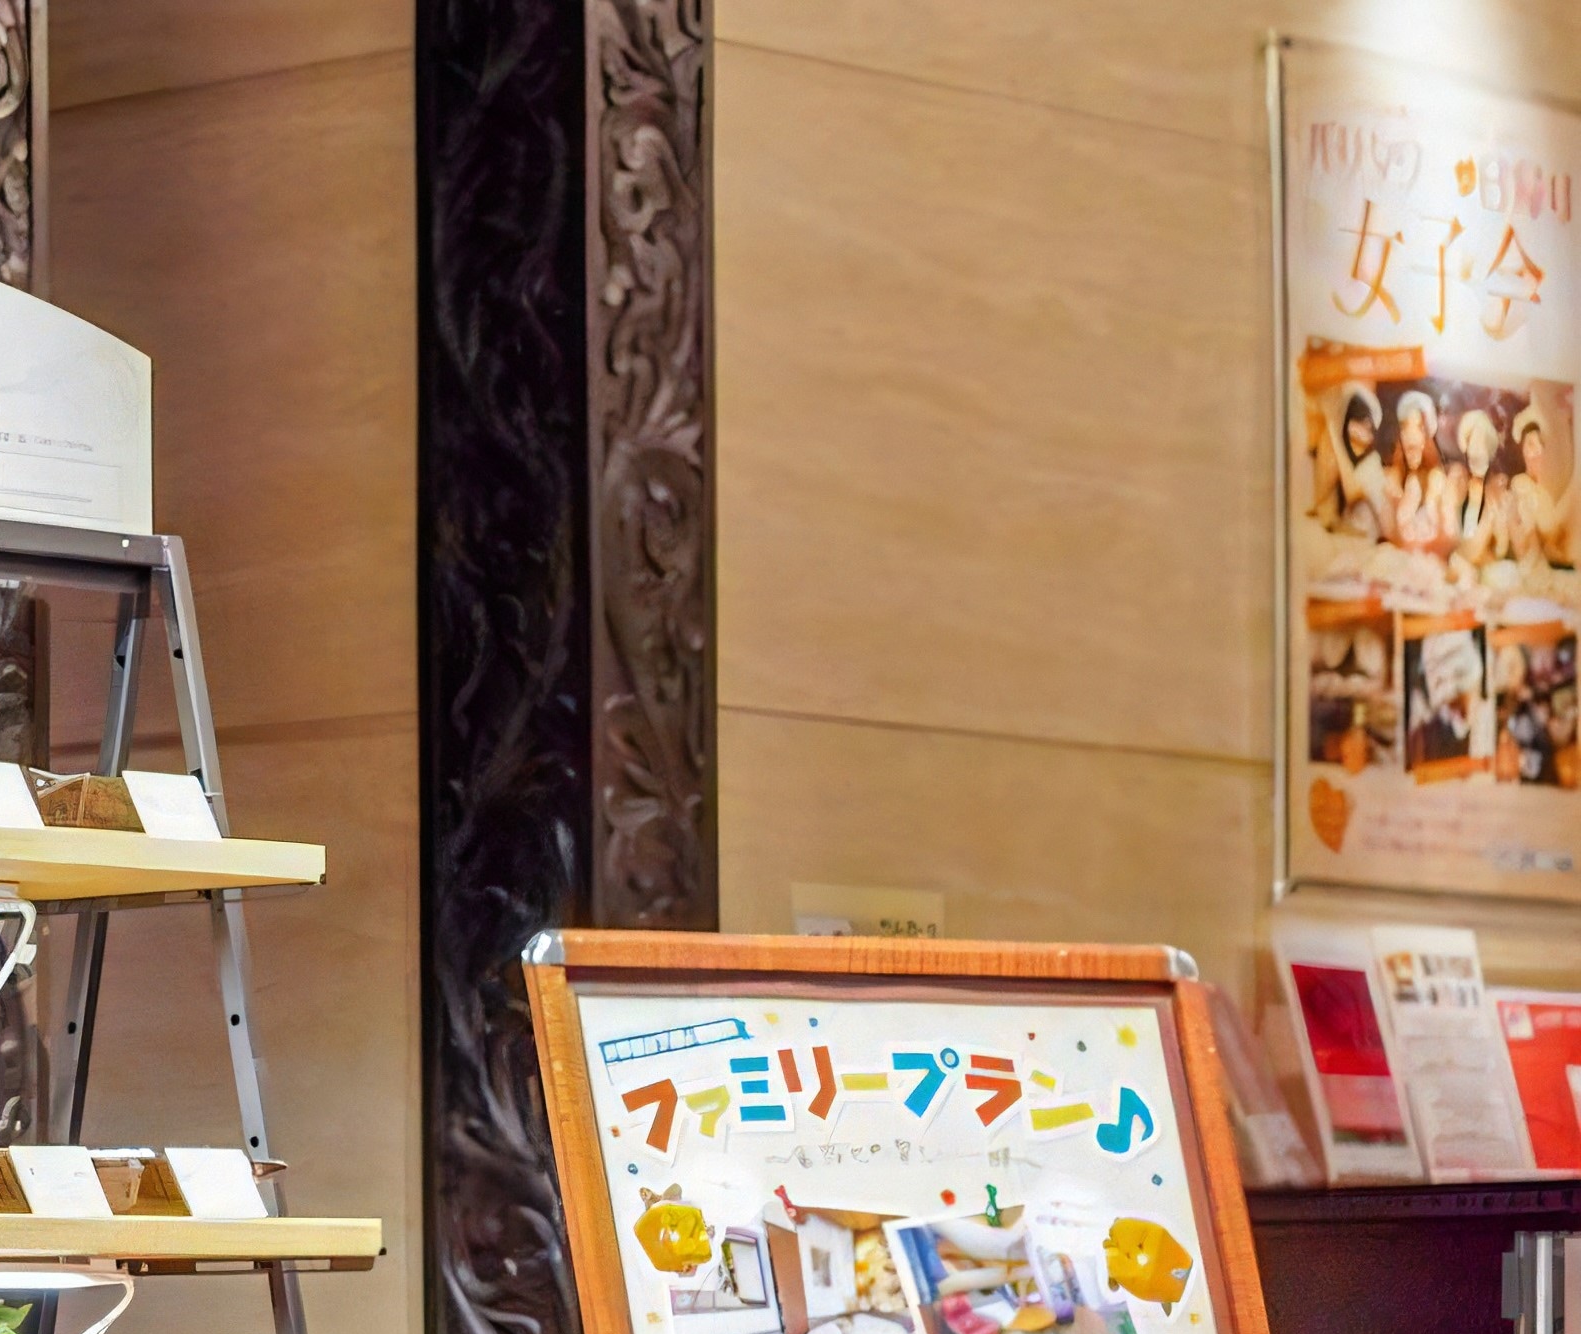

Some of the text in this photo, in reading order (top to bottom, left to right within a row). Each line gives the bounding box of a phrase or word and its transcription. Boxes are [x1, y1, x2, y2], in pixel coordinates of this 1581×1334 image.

[1330, 199, 1546, 342] 女子会
[621, 1045, 1096, 1153] ファミリープラン
